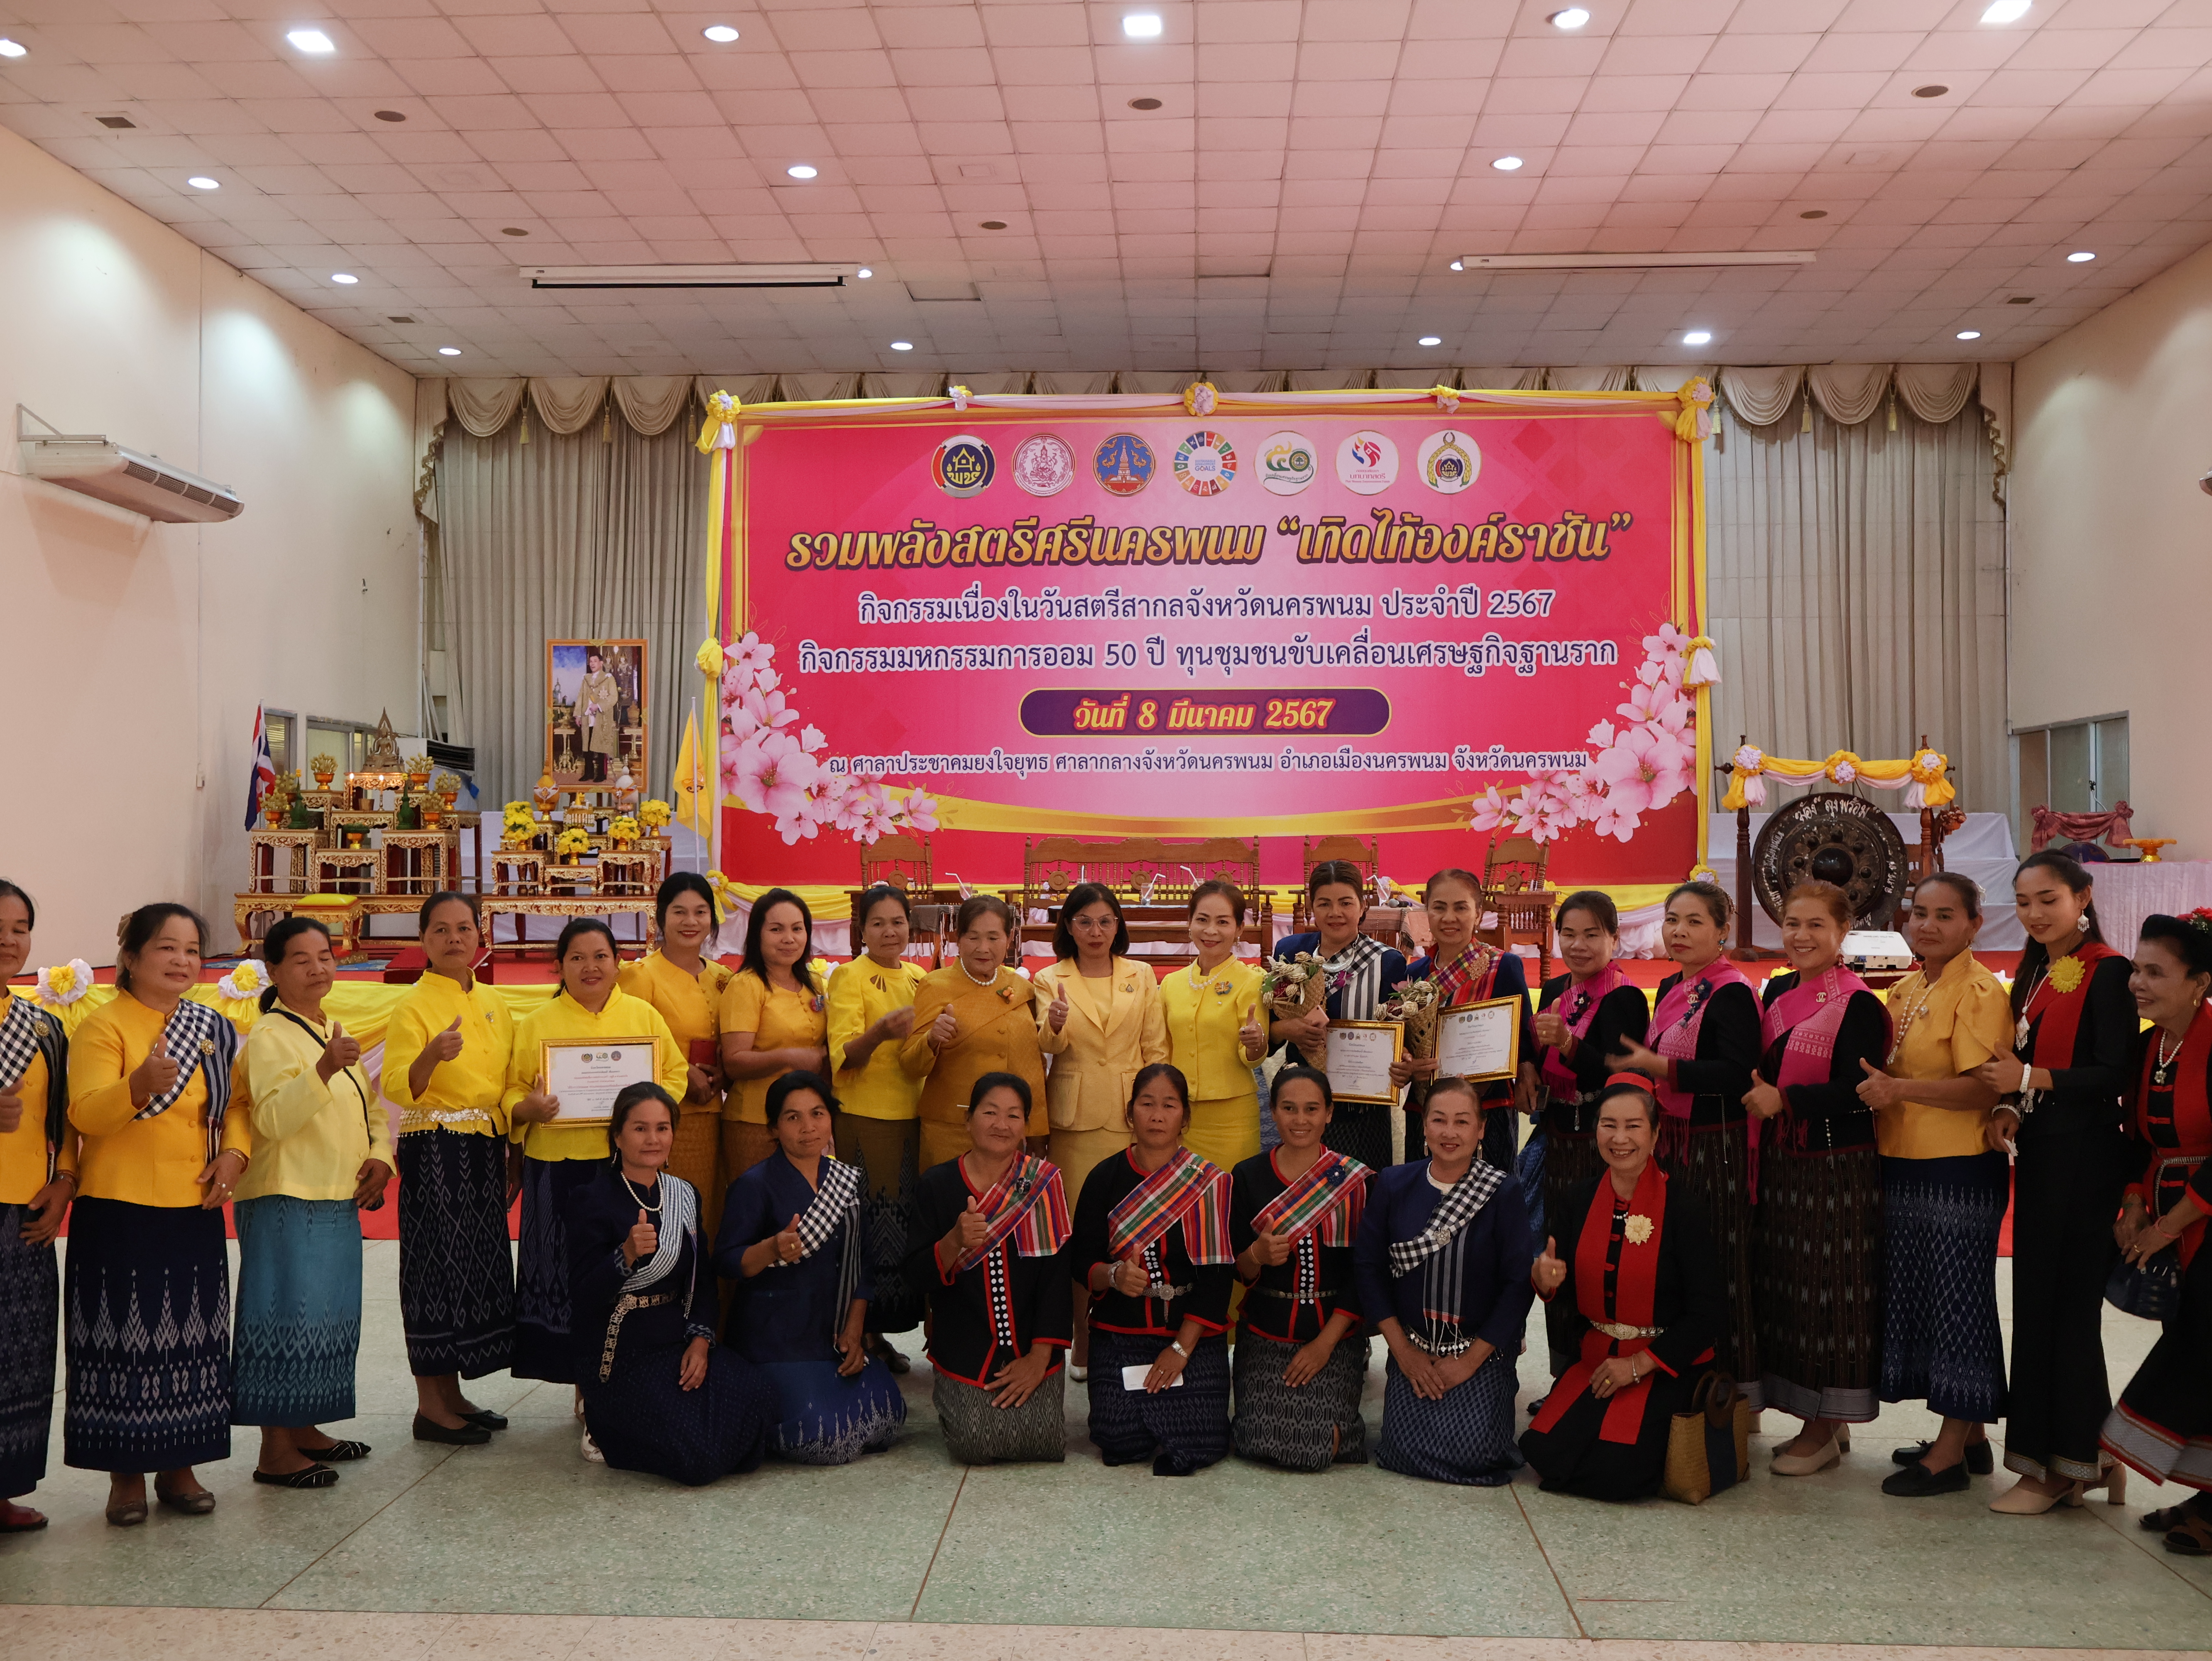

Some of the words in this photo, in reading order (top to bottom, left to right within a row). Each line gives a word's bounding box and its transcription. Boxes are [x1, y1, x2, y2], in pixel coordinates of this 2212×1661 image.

[784, 515, 1267, 571] รวมพลังสตรีศรีนครพนม
[859, 583, 1372, 622] กิจกรรมเนื่องในวันสตรีสากลจังหวัดนครพนม
[1382, 587, 1478, 616] ประจำปี
[1490, 591, 1554, 615] 2567
[801, 642, 1093, 670] กิจกรรมมหกรรมการออม
[1105, 643, 1137, 667] 50
[1146, 638, 1165, 666] ปี
[1177, 629, 1616, 675] ทุนชุมชนขับเคลื่อนเศรษฐกิจฐานราก
[1074, 694, 1129, 729] วันที่
[1139, 702, 1157, 728] 8
[1168, 700, 1255, 729] มีนาคม
[1266, 699, 1334, 728] 2567
[830, 758, 846, 773] ณ
[853, 751, 1048, 778] ศาลาประชาคมยงใจยุทธ
[1055, 749, 1273, 772] ศาลากลางจังหวัดนครพนม
[1280, 747, 1447, 770] อำเภอเมืองนครพนม
[1454, 748, 1587, 769] จังหวัดนครพนม
